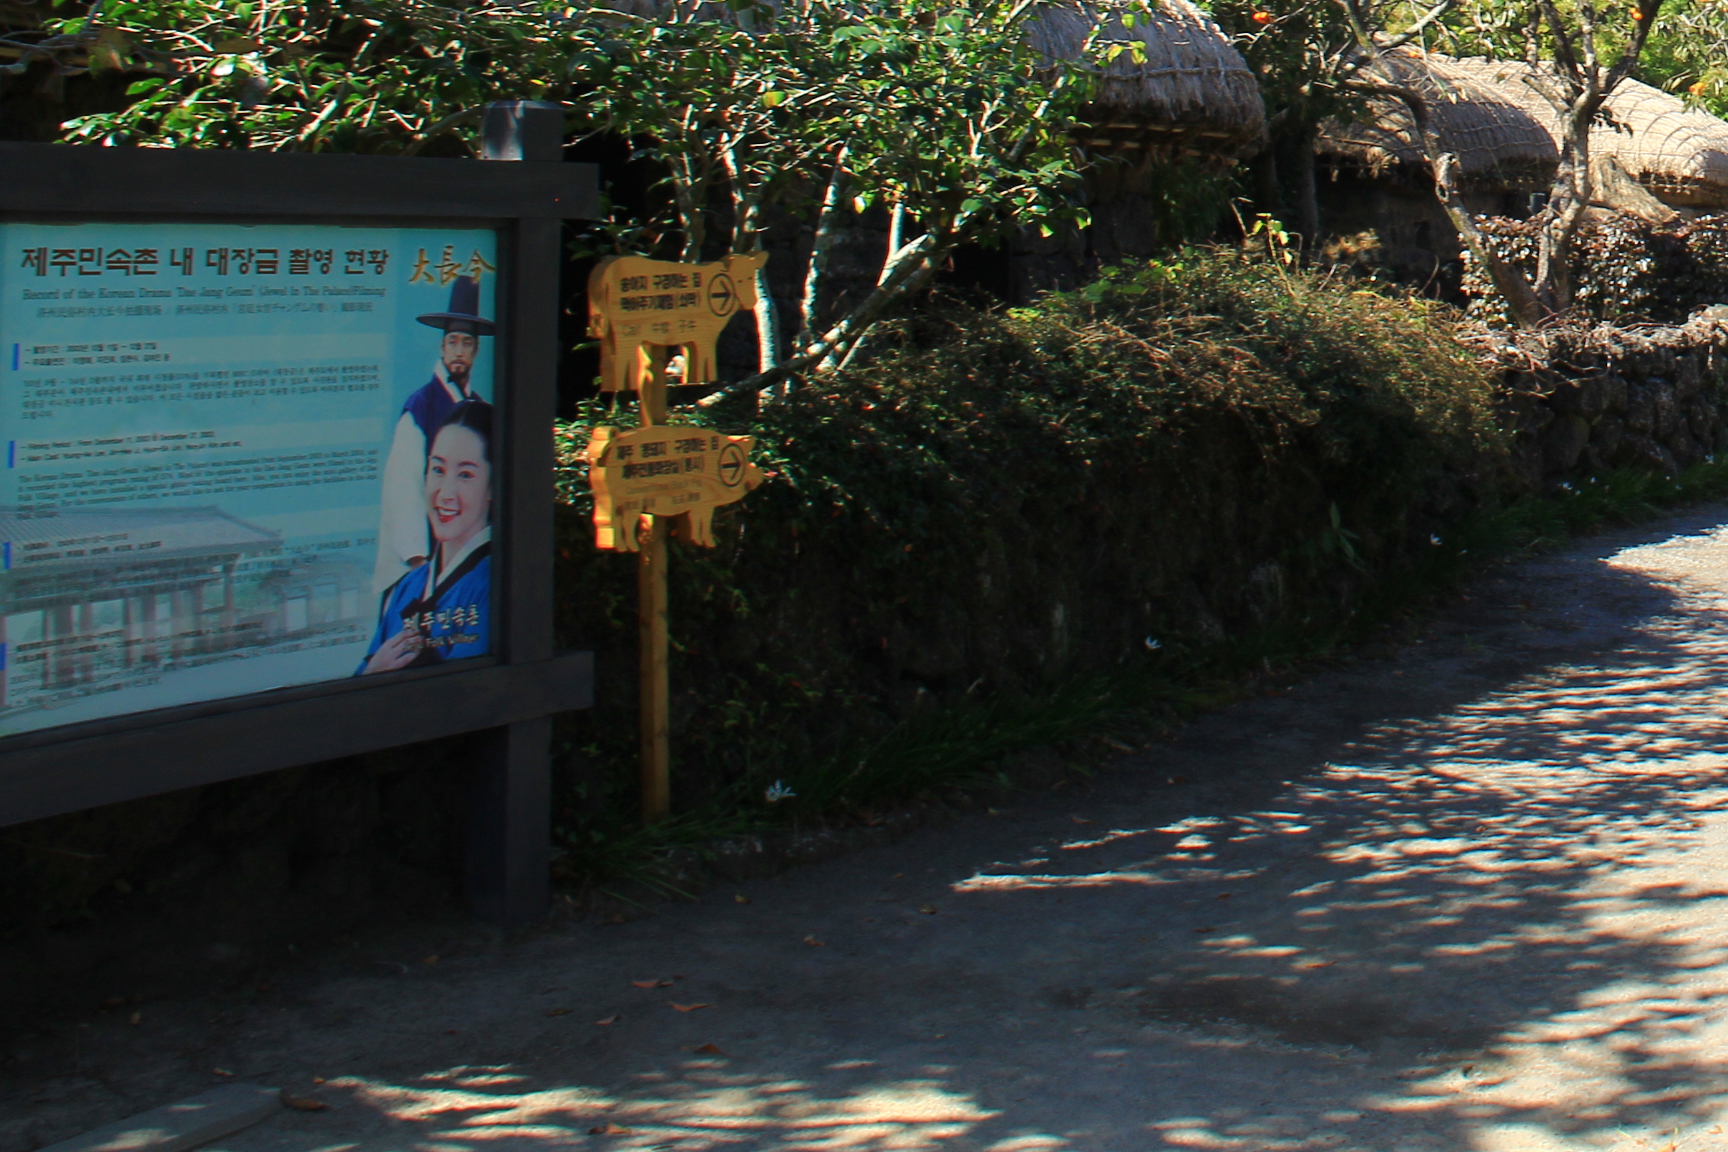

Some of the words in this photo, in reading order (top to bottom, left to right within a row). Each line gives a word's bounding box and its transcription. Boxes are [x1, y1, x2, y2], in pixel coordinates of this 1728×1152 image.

[21, 247, 159, 277] 제주민속촌
[170, 247, 194, 276] 내
[206, 247, 279, 276] 대장금
[289, 247, 333, 276] 촬영
[345, 247, 389, 276] 현황
[409, 245, 497, 285] 大長今
